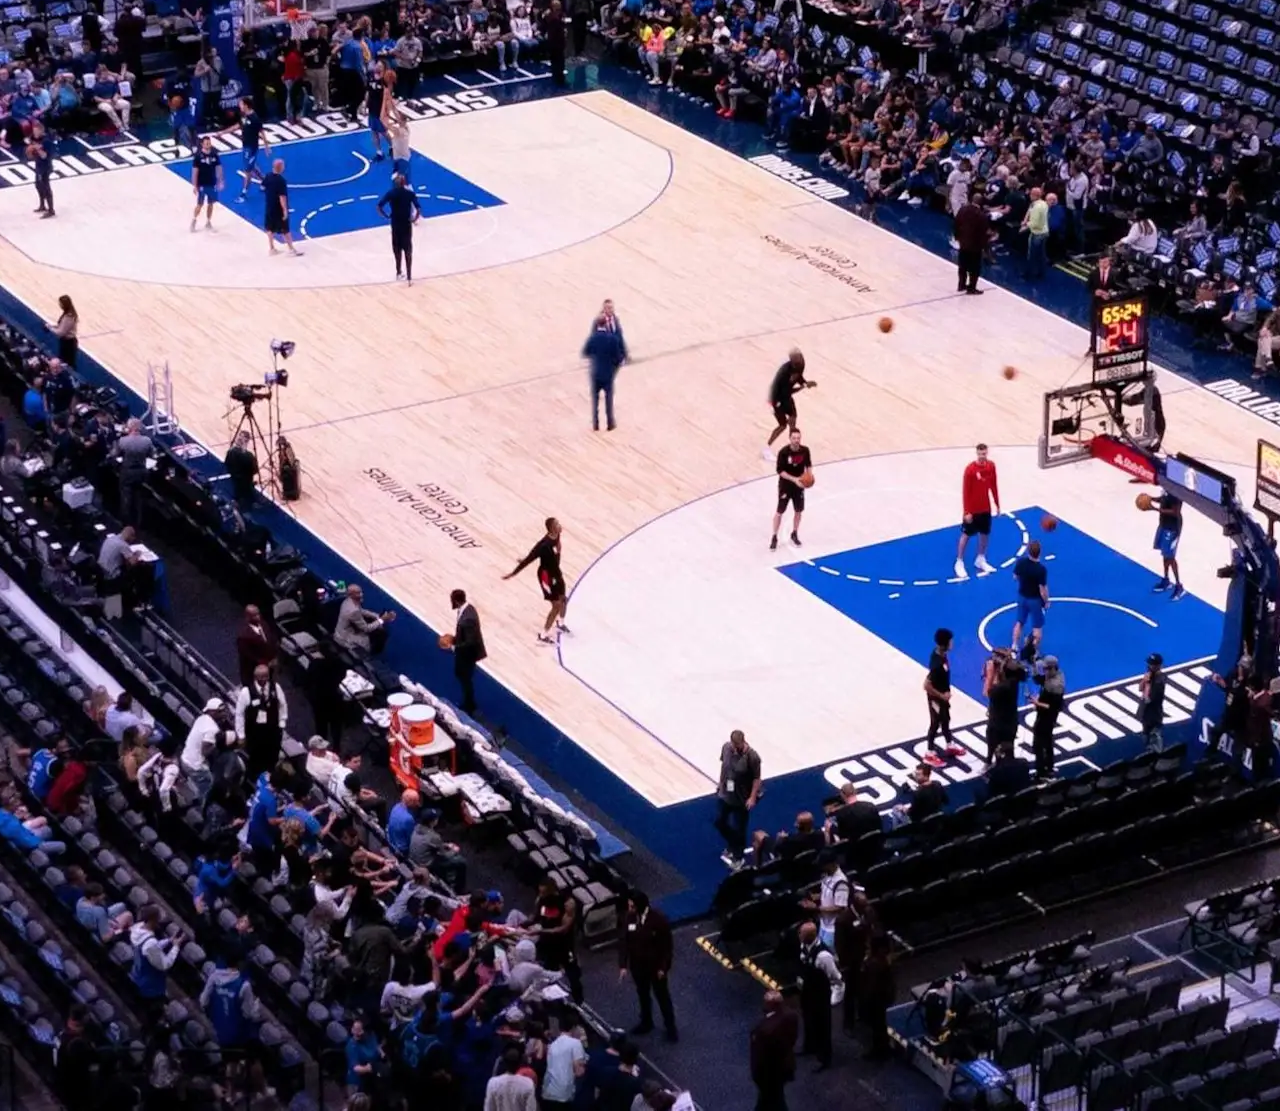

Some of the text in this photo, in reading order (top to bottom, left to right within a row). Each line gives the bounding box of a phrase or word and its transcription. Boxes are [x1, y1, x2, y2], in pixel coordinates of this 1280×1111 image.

[1102, 303, 1142, 325] 65:24
[1106, 320, 1137, 351] 24
[1112, 349, 1144, 363] TISSOT
[417, 482, 469, 515] Center
